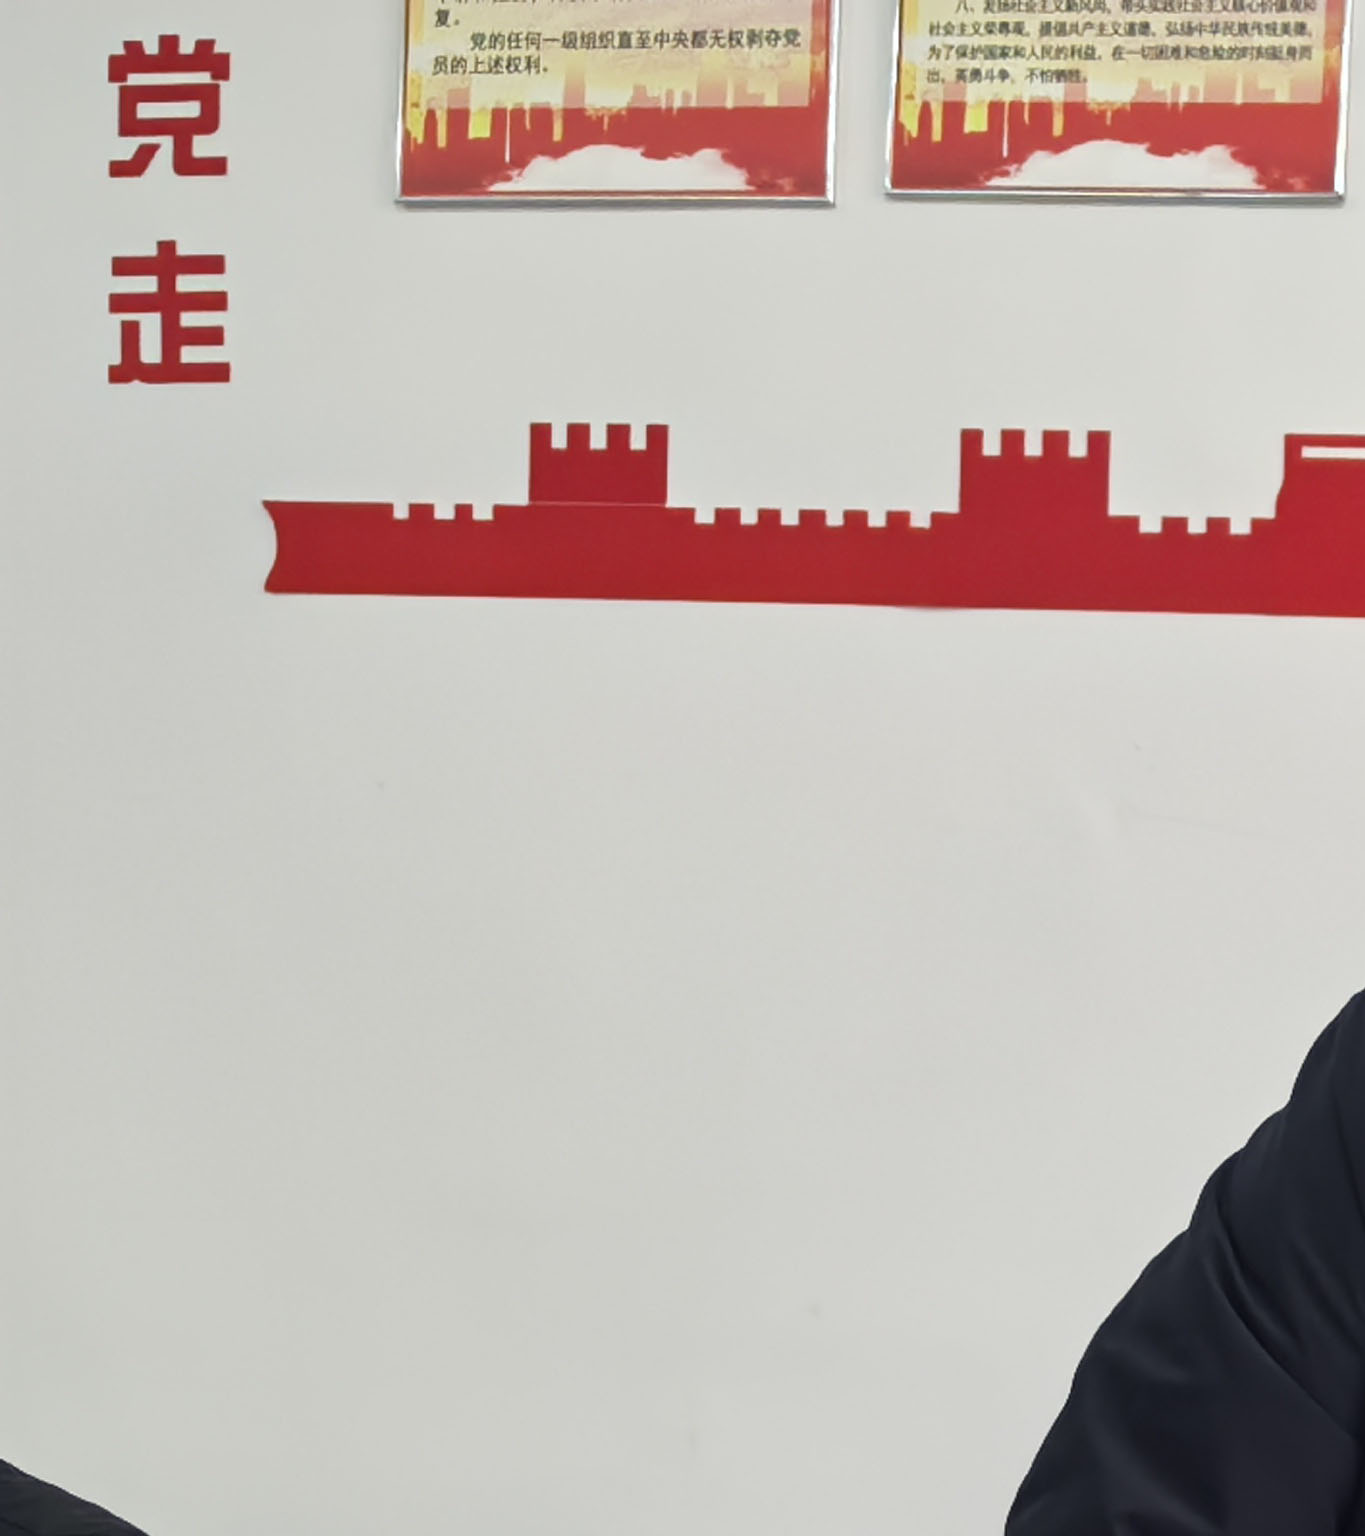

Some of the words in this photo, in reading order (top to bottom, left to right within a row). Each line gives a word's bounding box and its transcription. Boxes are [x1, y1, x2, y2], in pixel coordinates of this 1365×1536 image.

[470, 28, 801, 51] 党的任何一级组织直至中央都无权剥夺党
[432, 54, 548, 76] 员的上述权利。
